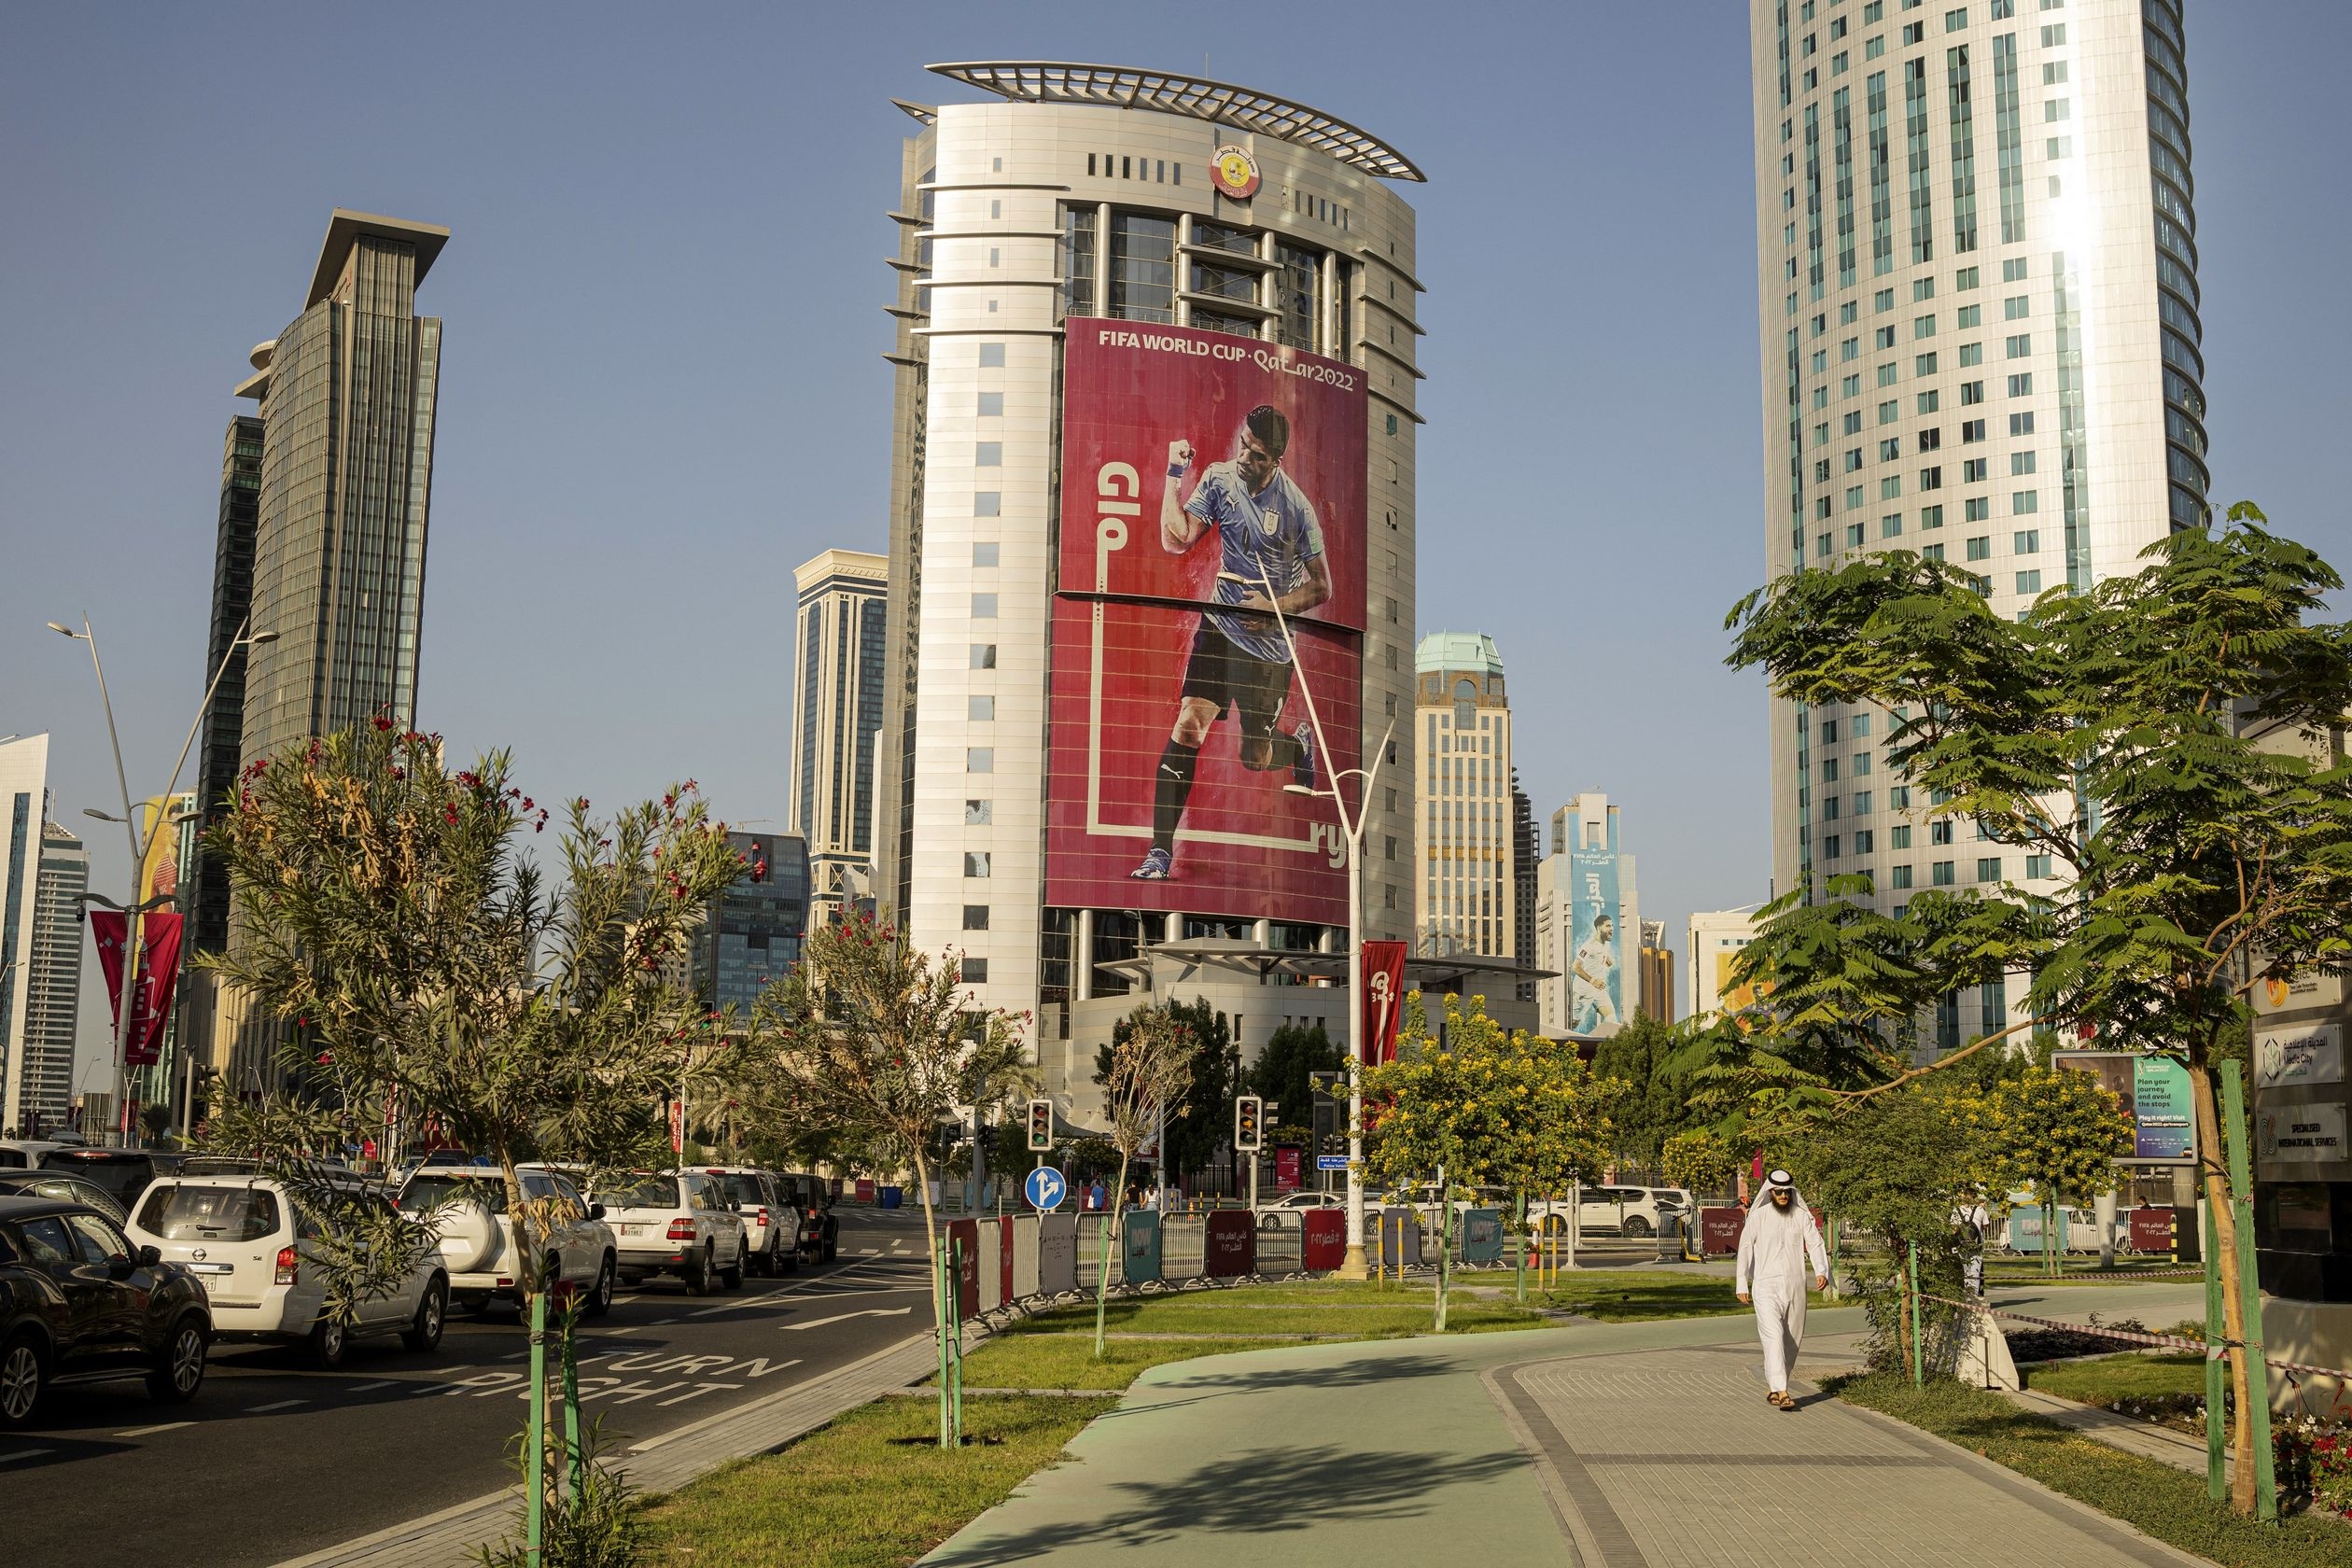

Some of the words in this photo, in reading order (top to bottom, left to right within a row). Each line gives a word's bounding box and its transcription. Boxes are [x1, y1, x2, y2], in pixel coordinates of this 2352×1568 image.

[1099, 330, 1141, 348] FIFA
[1142, 335, 1210, 357] WORLD
[1212, 343, 1246, 362] CUP
[2300, 1053, 2313, 1065] City
[2291, 1123, 2320, 1133] SPECIALISED
[2278, 1138, 2314, 1148] INTERNATIONAL
[2315, 1137, 2337, 1147] SERVICES
[576, 1350, 805, 1378] TURN
